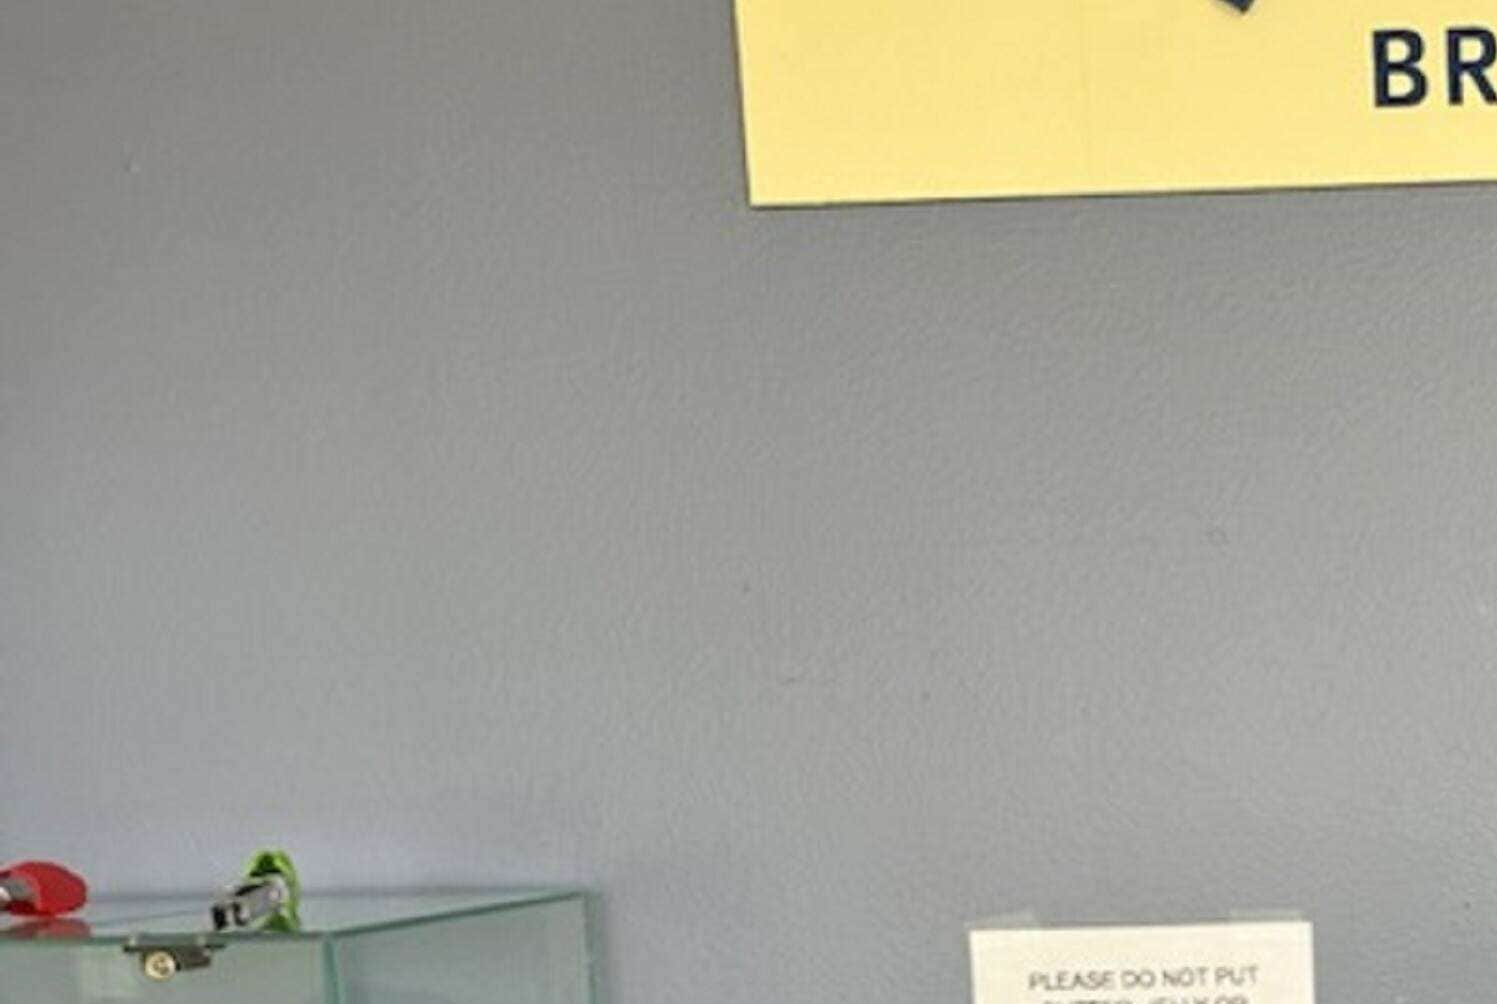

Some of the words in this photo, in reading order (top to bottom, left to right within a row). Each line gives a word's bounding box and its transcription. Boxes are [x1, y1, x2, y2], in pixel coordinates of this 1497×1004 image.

[1028, 970, 1116, 992] PLEASE
[1121, 968, 1157, 989] DO
[1162, 966, 1209, 988] NOT
[1214, 964, 1259, 987] PUT
